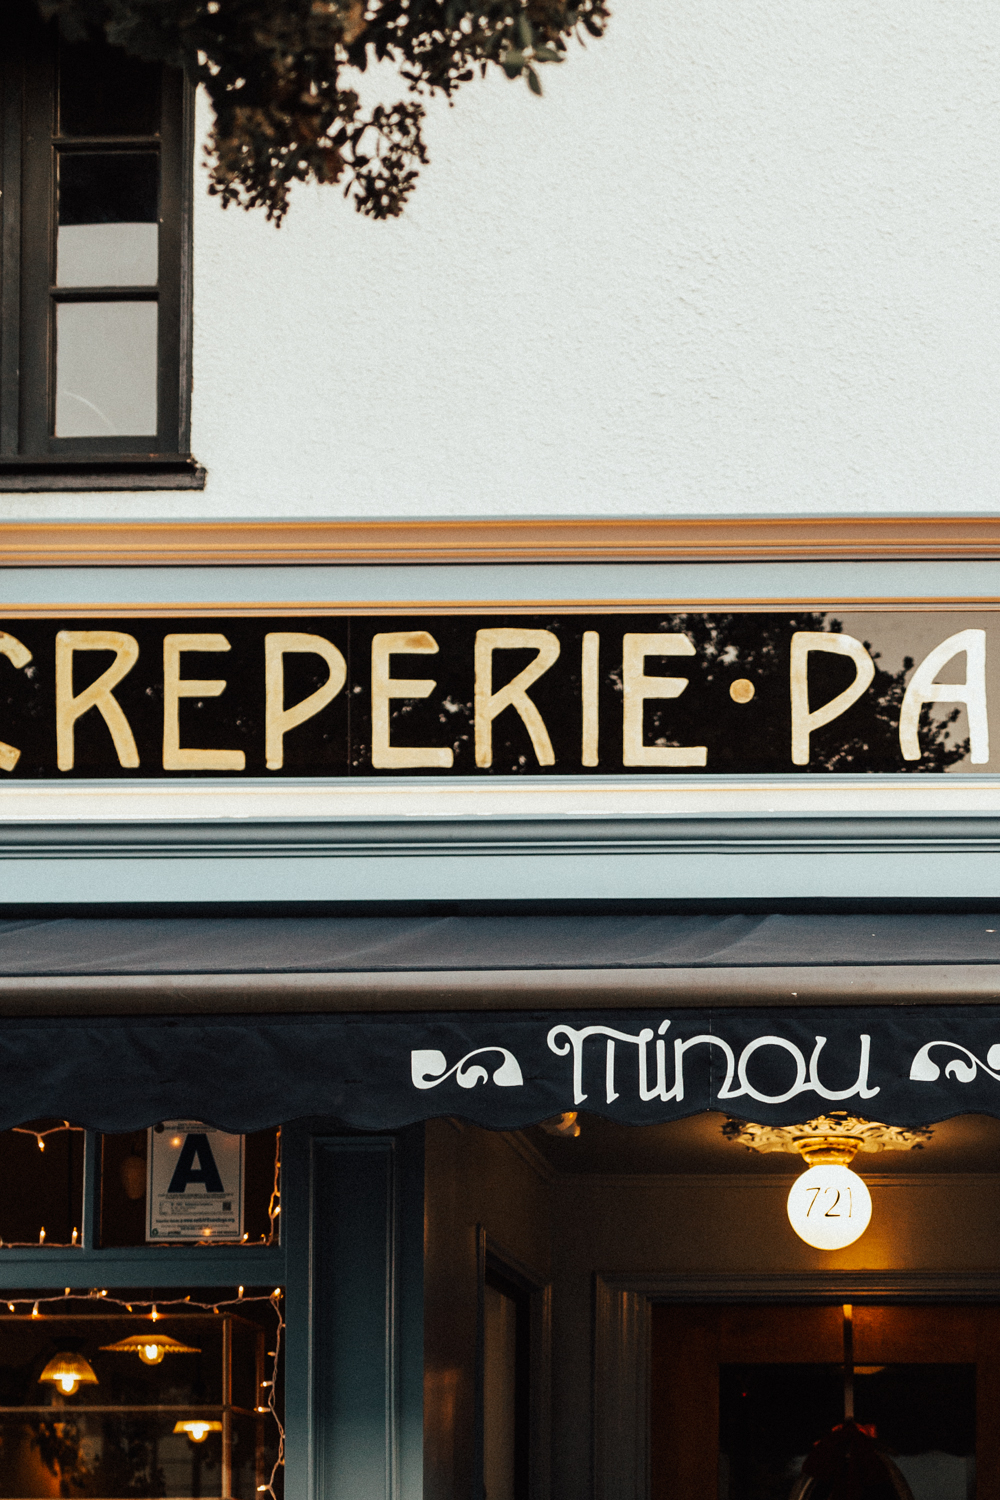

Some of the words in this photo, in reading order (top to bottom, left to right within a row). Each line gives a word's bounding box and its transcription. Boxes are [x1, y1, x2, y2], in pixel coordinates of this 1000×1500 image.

[546, 1019, 881, 1105] Minou
[167, 1133, 225, 1193] A
[806, 1186, 853, 1218] 721
